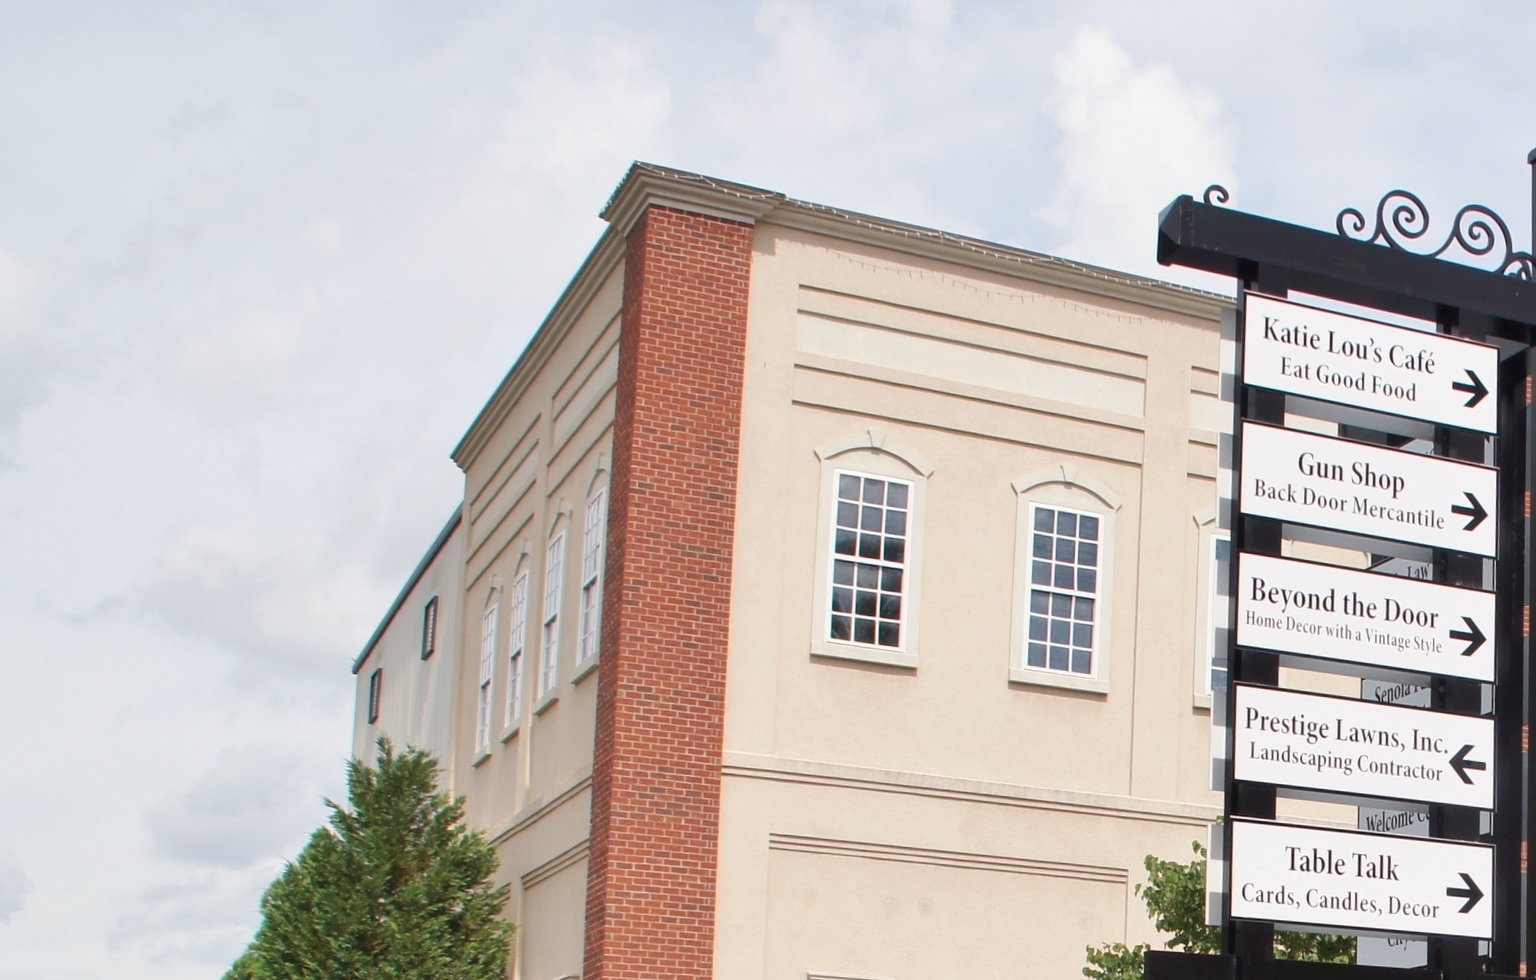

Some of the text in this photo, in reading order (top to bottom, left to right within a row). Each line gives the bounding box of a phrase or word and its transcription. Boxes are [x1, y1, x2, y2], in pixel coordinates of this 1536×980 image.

[1262, 316, 1436, 375] Katie Lou's Café
[1280, 356, 1417, 402] Eat Good Food
[1298, 452, 1405, 499] Gun Shop
[1254, 478, 1445, 530] Back Door Mercantile
[1250, 576, 1440, 629] Beyond the Door
[1245, 609, 1443, 656] Home Decor with a Vintage Style
[1244, 706, 1449, 755] Prestige Lawns, Inc.
[1249, 741, 1444, 782] Landscaping Contractor
[1366, 811, 1415, 833] Welcome
[1285, 846, 1400, 882] Table Talk
[1241, 882, 1440, 919] Cards, Candles, Decor
